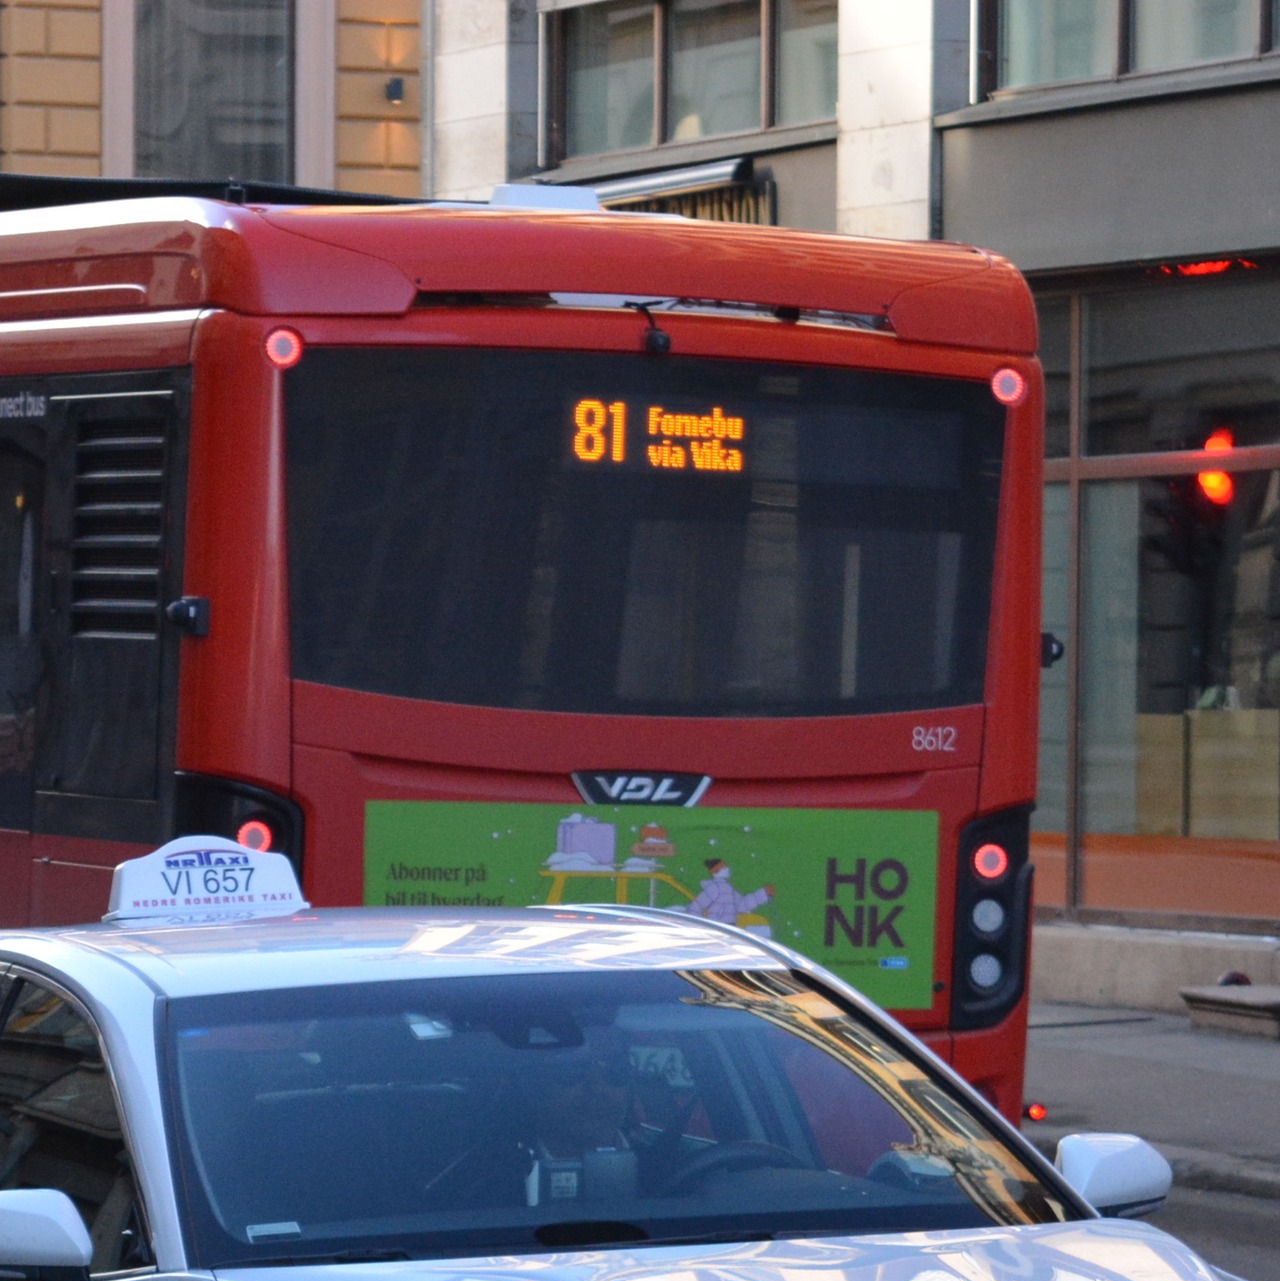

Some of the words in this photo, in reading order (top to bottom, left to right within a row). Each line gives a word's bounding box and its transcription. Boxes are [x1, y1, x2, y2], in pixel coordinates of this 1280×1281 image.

[26, 391, 45, 417] bus
[574, 399, 626, 463] 81
[647, 407, 744, 440] Fornebu
[647, 440, 686, 468] via
[690, 438, 743, 472] Vika
[911, 726, 957, 752] 8612
[595, 775, 683, 802] VDL
[161, 870, 192, 896] VI
[203, 867, 255, 894] 657
[386, 863, 461, 881] Abonner
[464, 862, 488, 886] på
[133, 899, 177, 909] NEDRE
[184, 895, 255, 906] ROMERIKE
[262, 892, 293, 903] TAXI
